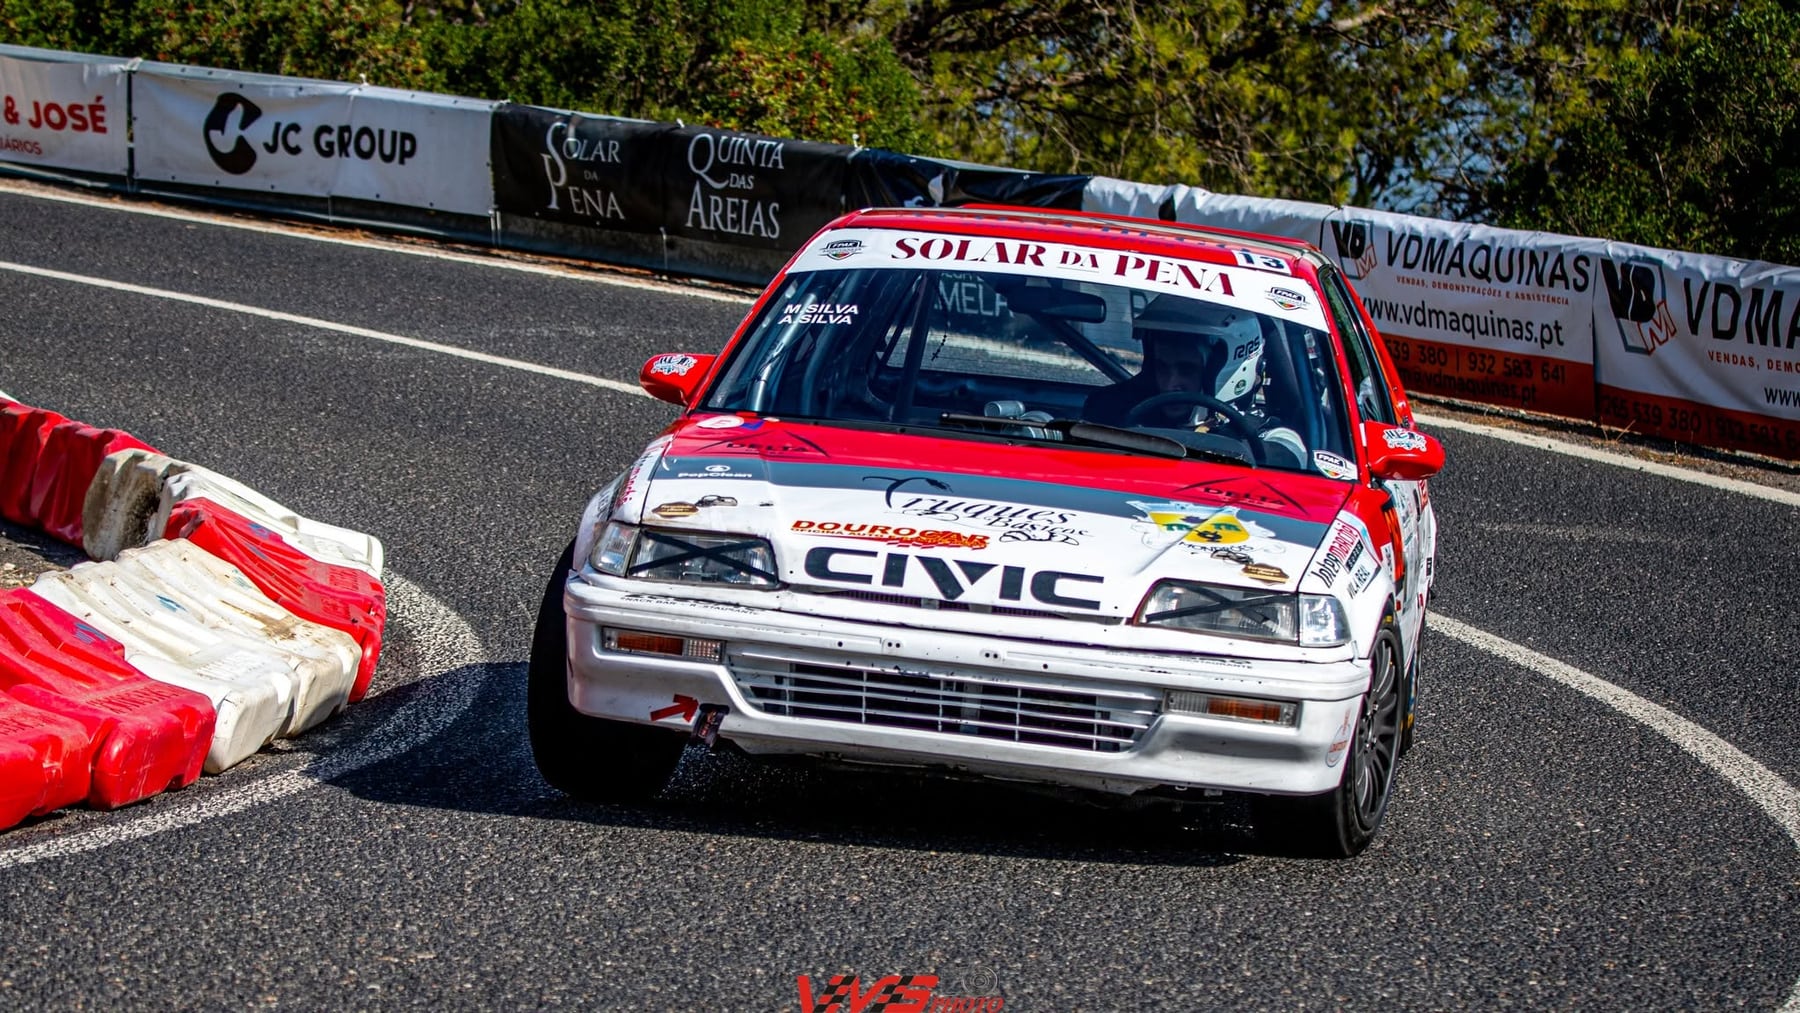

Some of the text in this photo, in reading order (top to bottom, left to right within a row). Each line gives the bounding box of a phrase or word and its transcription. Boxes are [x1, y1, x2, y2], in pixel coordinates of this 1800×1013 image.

[4, 95, 107, 134] & JOSÉ
[263, 121, 416, 165] JC GROUP
[546, 122, 621, 187] SOLAR
[688, 133, 785, 189] QUINTA
[540, 152, 625, 220] PENA
[584, 169, 598, 181] DA
[729, 172, 754, 190] DAS
[686, 180, 780, 239] AREIAS
[891, 237, 1235, 297] SOLAR DA PENA
[1240, 249, 1285, 270] 13
[1387, 230, 1591, 293] VDMÁQUINAS
[1396, 275, 1570, 306] VENDAS, DEMONSTRAÇÕES E ASSISTÊNCIA
[1363, 297, 1564, 349] ww.vdmaquinas.pt
[1233, 336, 1260, 361] RRS
[1418, 343, 1448, 367] 380
[1468, 351, 1496, 375] 932
[1503, 357, 1534, 379] 583
[1540, 363, 1566, 384] 641
[1708, 350, 1760, 371] VENDAS,
[1669, 407, 1699, 433] 380
[727, 443, 809, 453] DELTA
[1204, 487, 1287, 506] DELTA
[792, 520, 990, 546] DOUROCAR
[804, 546, 1104, 610] CIVIC
